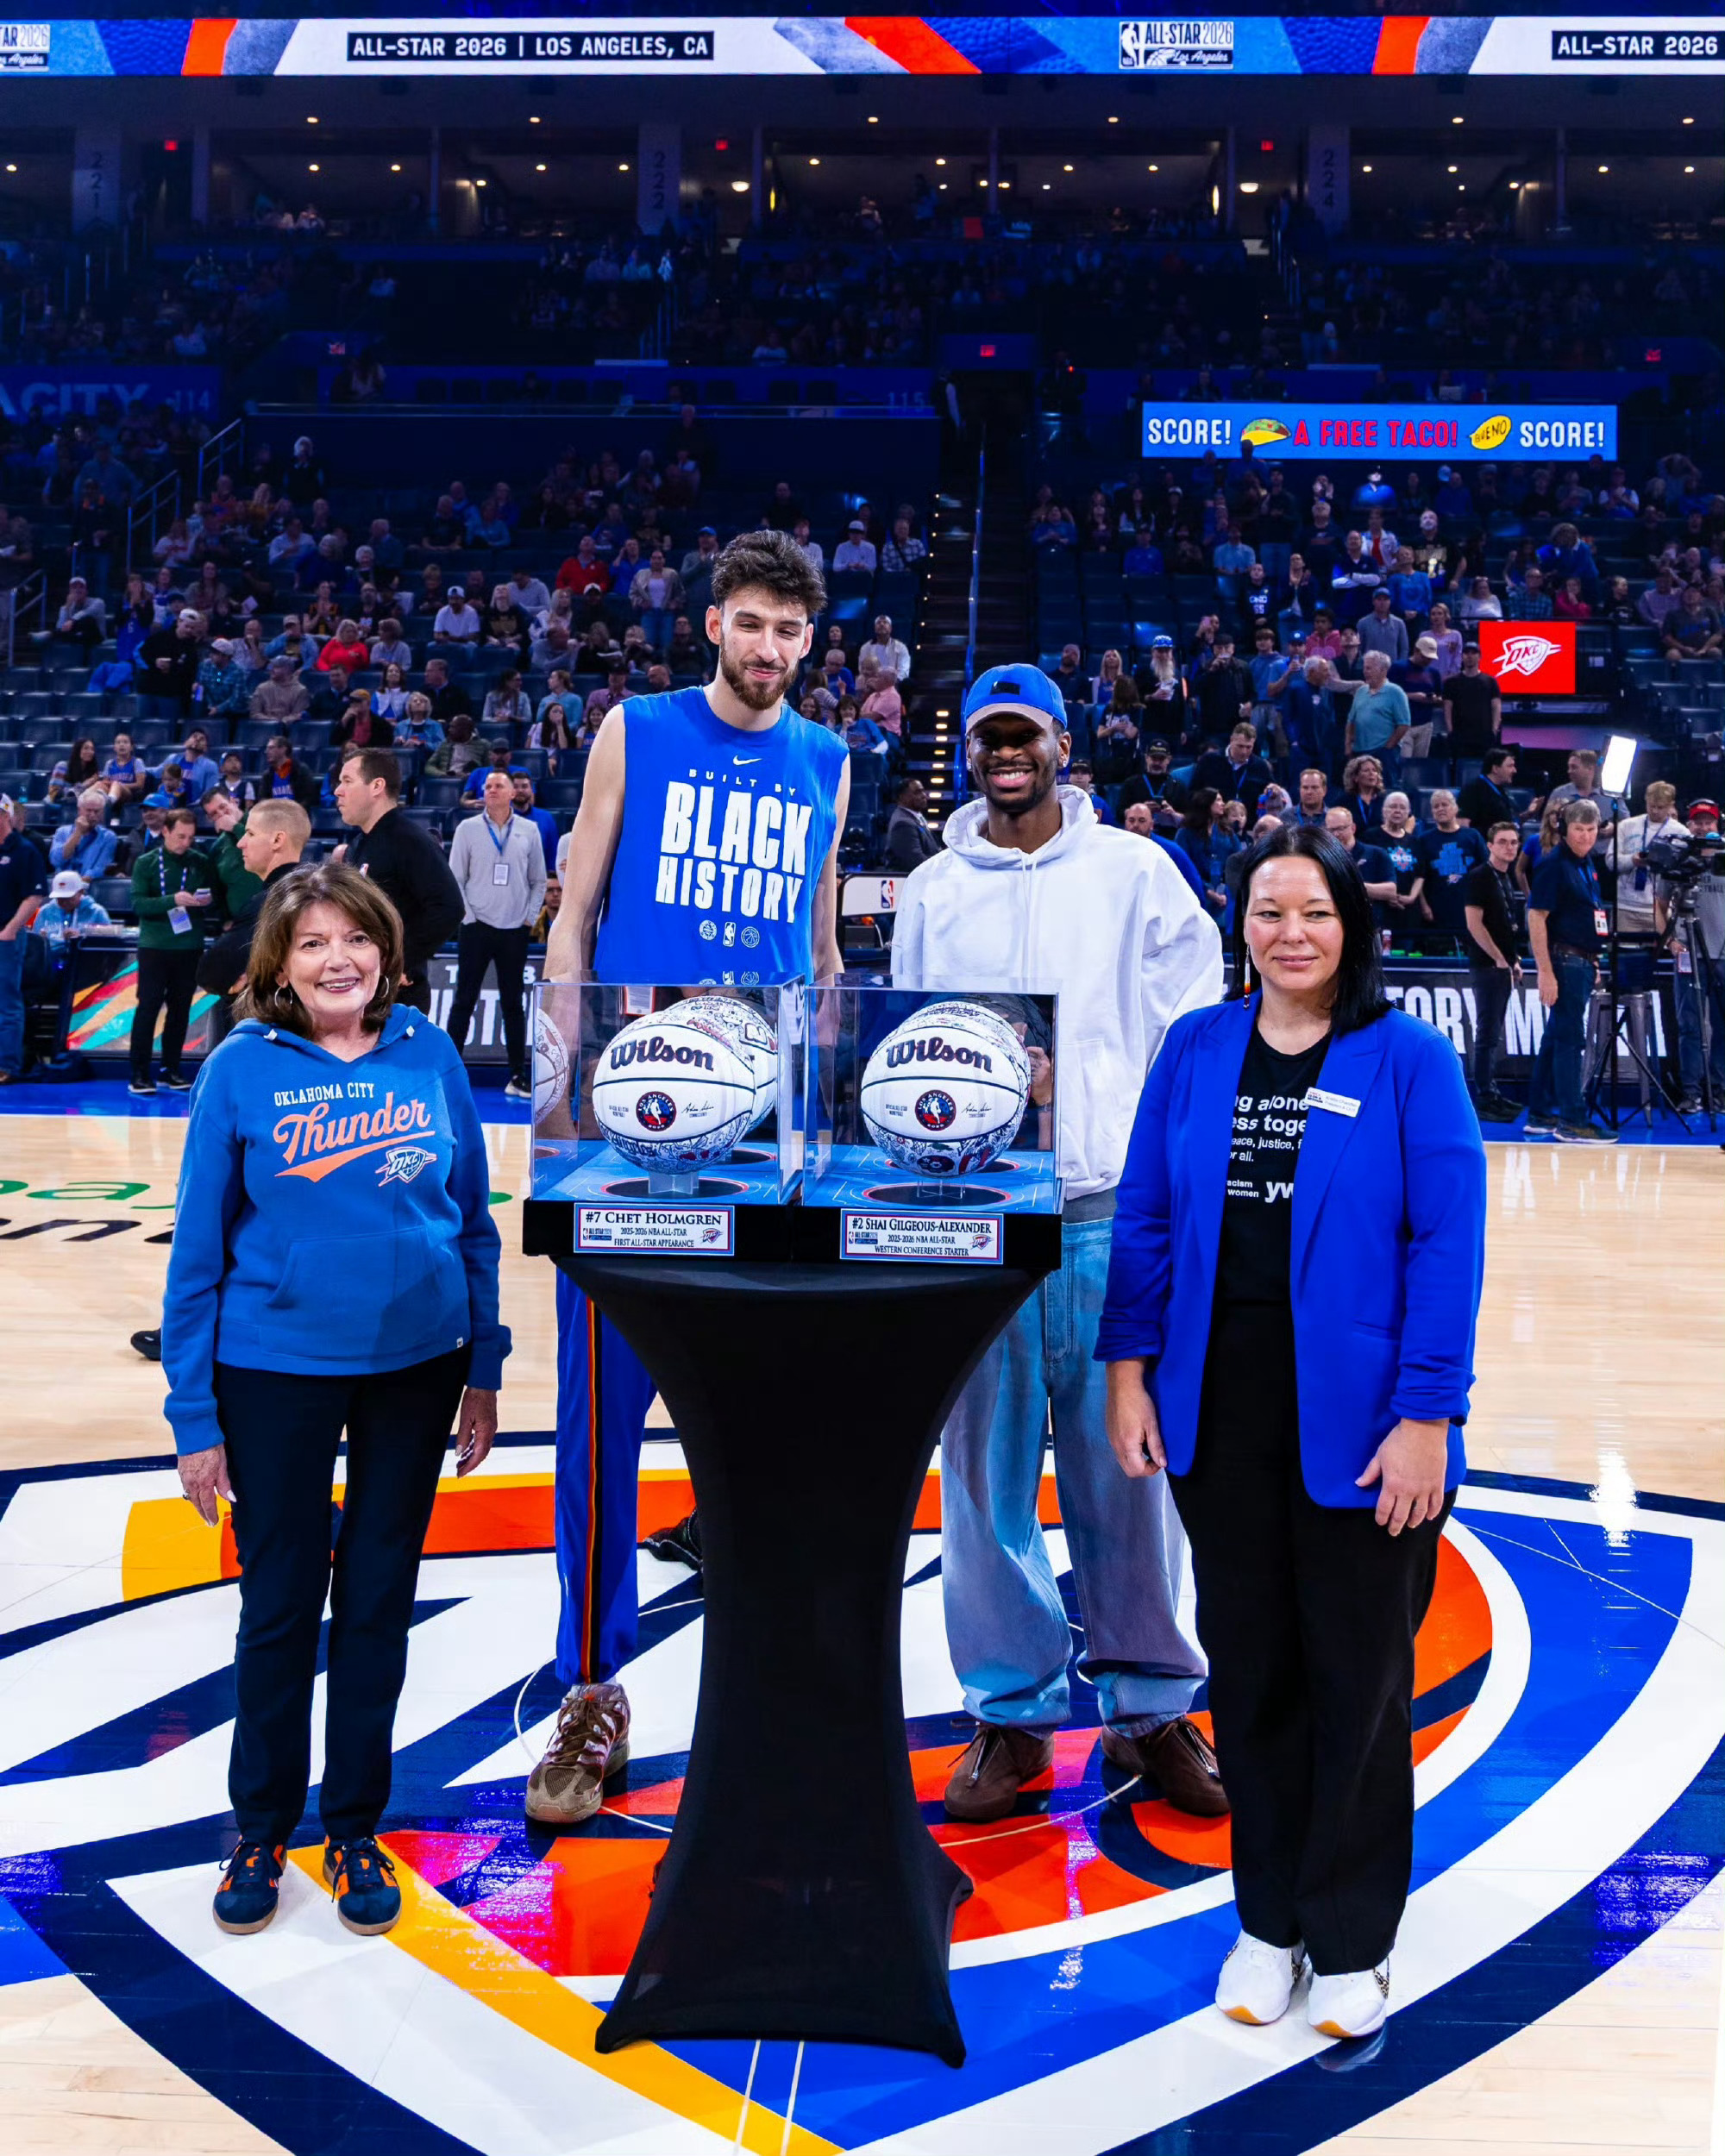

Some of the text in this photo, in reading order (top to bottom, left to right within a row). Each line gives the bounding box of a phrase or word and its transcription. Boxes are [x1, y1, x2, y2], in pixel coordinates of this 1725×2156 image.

[20, 26, 47, 47] 2026
[1203, 22, 1232, 44] 2026
[353, 38, 445, 56] ALL-STAR
[455, 38, 506, 56] 2026
[536, 37, 572, 55] LOS
[581, 37, 674, 59] ANGELES,
[683, 37, 708, 55] CA
[1558, 36, 1718, 55] ALL-STAR 2026
[1173, 49, 1229, 66] Los Angeles
[1324, 148, 1335, 208] 224
[1148, 418, 1458, 447] SCORE! A FREE TACO!
[1475, 419, 1507, 442] BUENO
[1520, 421, 1604, 448] SCORE!
[689, 768, 795, 796] BUILT BY
[661, 780, 812, 876] BLACK
[656, 855, 803, 924] HISTORY
[610, 1037, 714, 1072] Wilson
[887, 1037, 992, 1073] Wilson
[274, 1082, 374, 1106] OKLAHOMA CITY
[637, 1098, 647, 1112] LOS
[648, 1093, 674, 1112] ANGELES
[918, 1097, 927, 1110] LOS
[928, 1093, 954, 1111] ANGELES
[1235, 1095, 1252, 1112] g
[273, 1091, 431, 1165] Thunder
[1258, 1137, 1294, 1150] justice,
[389, 1152, 418, 1175] OKC
[1239, 1151, 1254, 1162] all.
[1227, 1188, 1259, 1198] women
[586, 1211, 601, 1223] #7
[852, 1217, 862, 1229] #2
[631, 1238, 656, 1247] ALL-STAR
[658, 1239, 694, 1248] APPEARANCE
[888, 1234, 914, 1243] 2025-2026
[930, 1236, 956, 1244] ALL-STAR
[903, 1246, 942, 1255] CONFERENCE
[944, 1247, 969, 1256] STARTER
